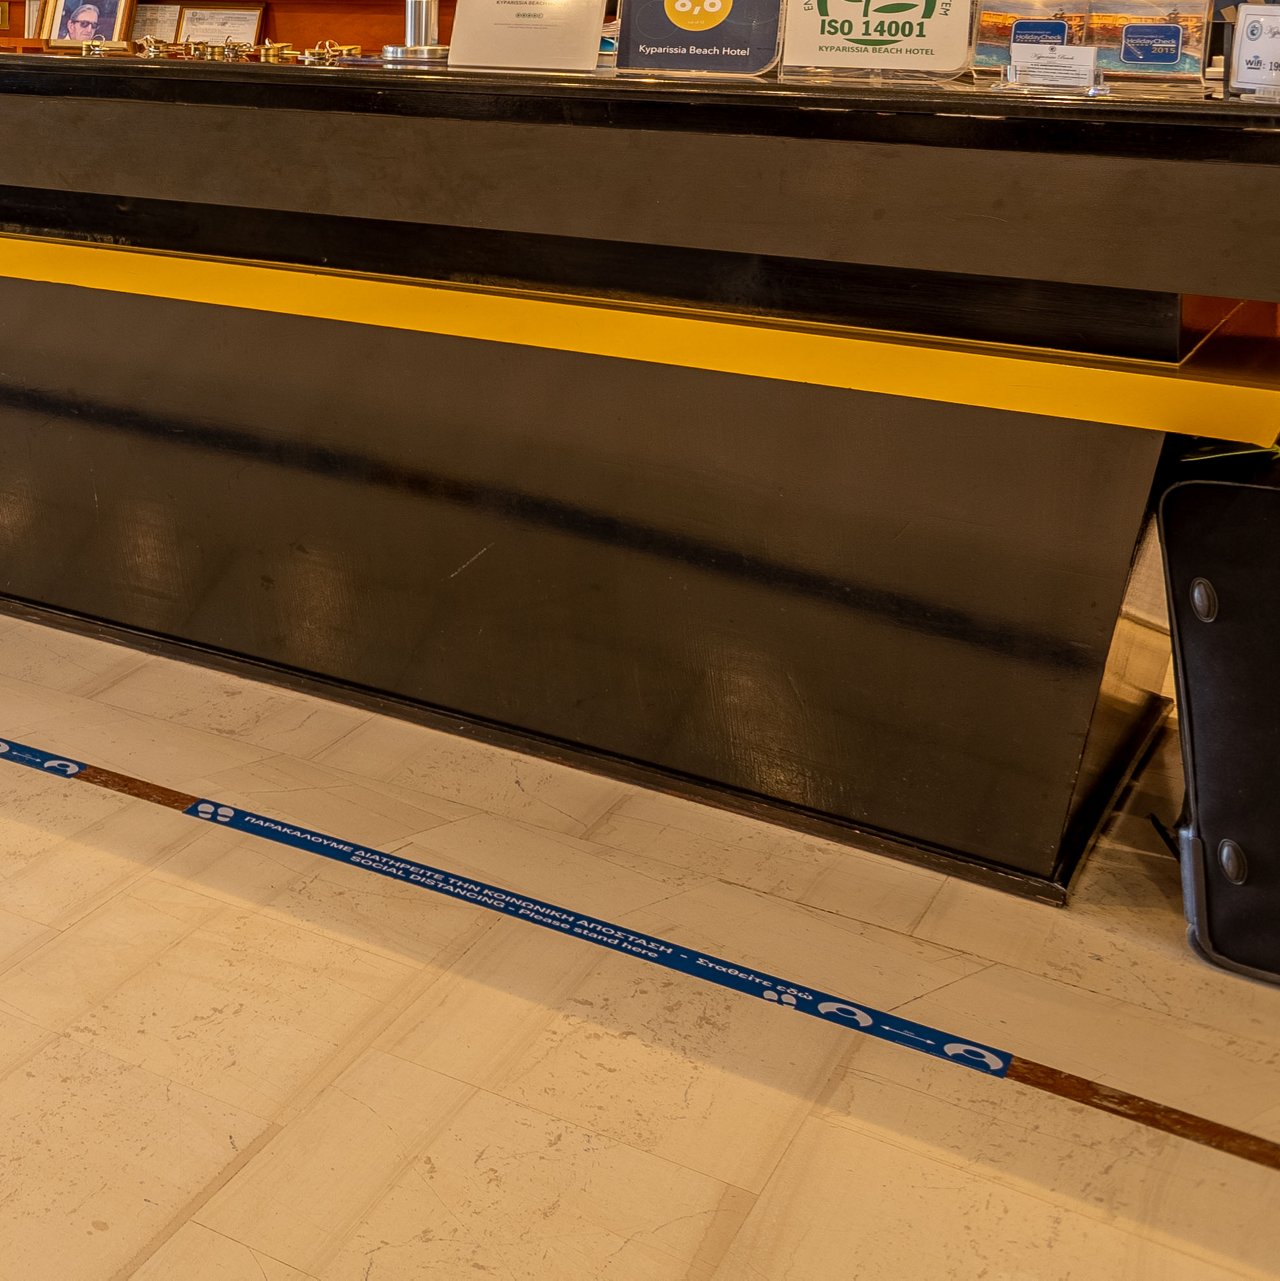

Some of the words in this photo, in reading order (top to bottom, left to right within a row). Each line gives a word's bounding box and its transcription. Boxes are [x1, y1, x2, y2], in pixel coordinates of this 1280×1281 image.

[820, 19, 853, 36] ISO
[861, 20, 926, 38] 14001
[1126, 38, 1177, 46] HolidayCheck
[639, 44, 687, 57] Kyparissia
[689, 46, 720, 55] Beach
[722, 47, 750, 56] Hotel
[818, 45, 869, 53] KYPARISSIA
[872, 46, 902, 54] BEACH
[1151, 46, 1176, 54] 2015
[244, 816, 354, 853] ΠΑΡΑΚΑΛΟΥΜΕ
[354, 850, 445, 881] ΔΙΑΤΗΡΕΙΤΕ
[448, 877, 481, 892] ΤΗΝ
[483, 888, 576, 922] ΚΟΙΝΩΝΙΚΗ
[576, 919, 674, 954] ΑΠΟΣΤΑΣΗ
[695, 957, 773, 988] Σταθείτε
[775, 982, 814, 1002] εδώ
[350, 855, 407, 878] SOCIAL
[408, 874, 505, 909] DISTANCING
[518, 908, 571, 929] Please
[573, 924, 619, 946] stand
[622, 941, 659, 959] here
